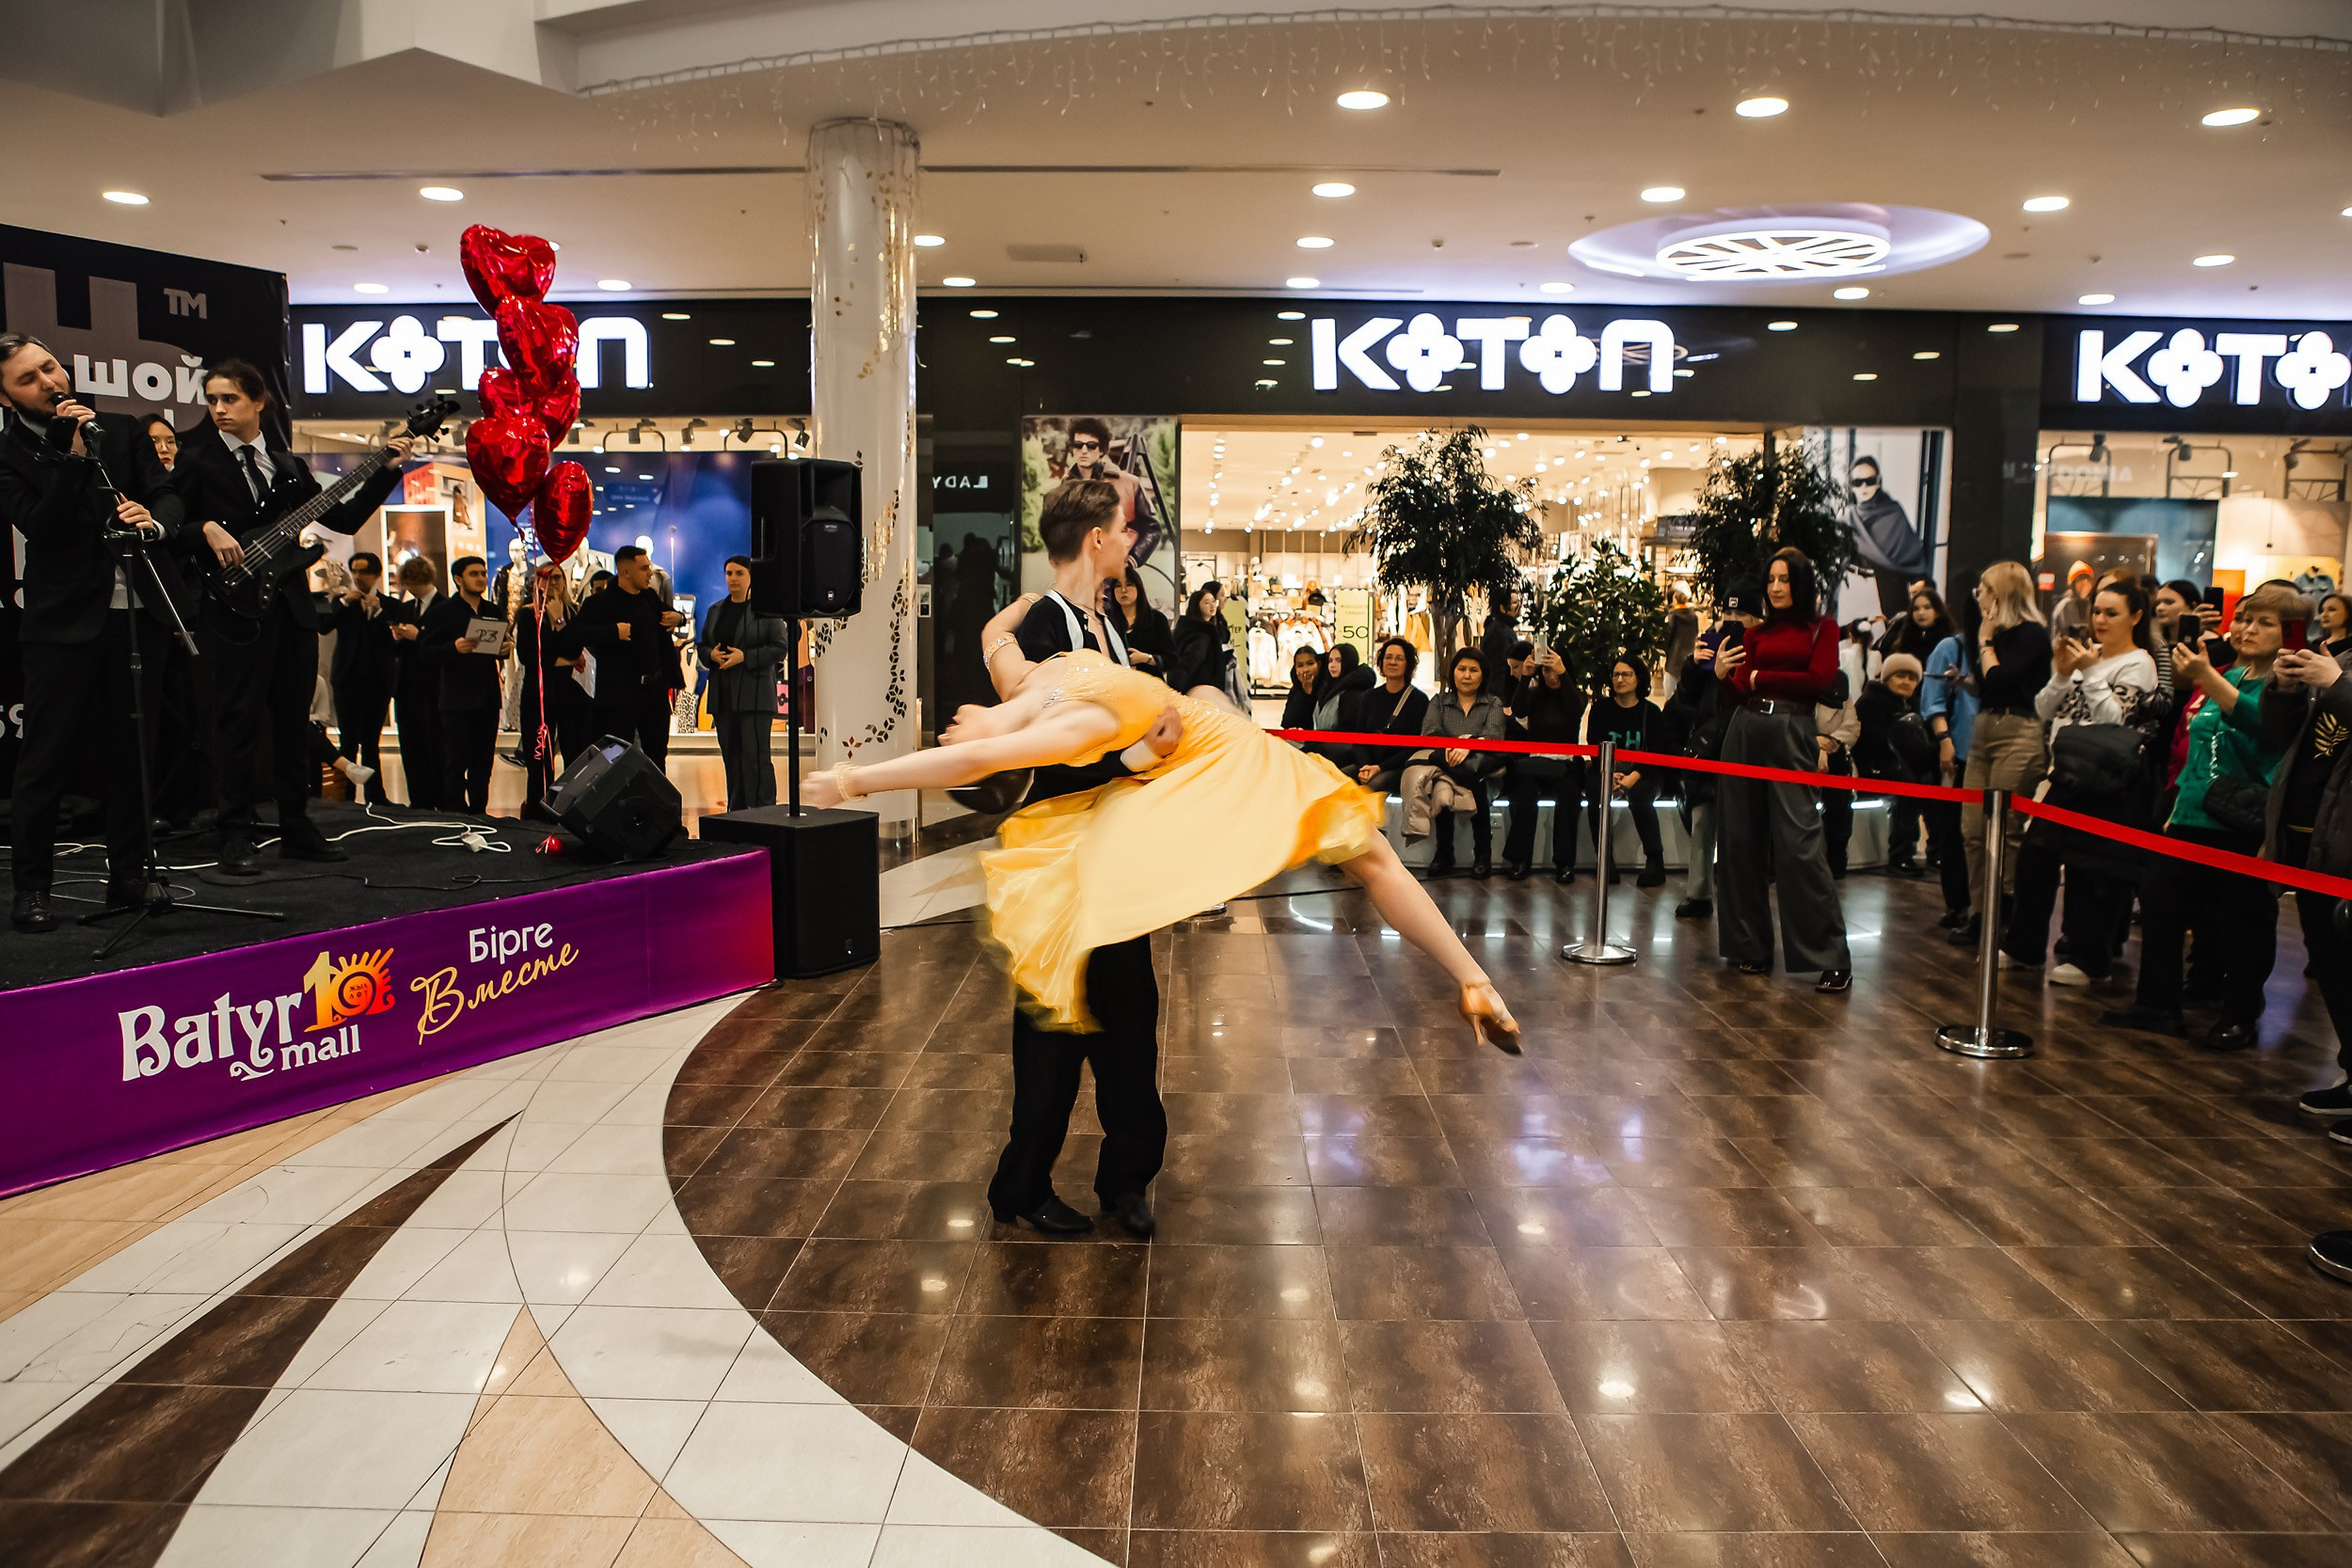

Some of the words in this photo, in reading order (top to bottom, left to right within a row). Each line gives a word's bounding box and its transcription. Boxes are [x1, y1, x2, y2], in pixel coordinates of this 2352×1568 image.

[302, 315, 649, 393] KOTN
[1311, 312, 1676, 395] KOTON
[2075, 327, 2352, 410] KOTO
[469, 923, 553, 965] Бірге
[410, 942, 580, 1045] Вместе
[118, 991, 302, 1082] Batyr
[280, 1024, 361, 1070] mall
